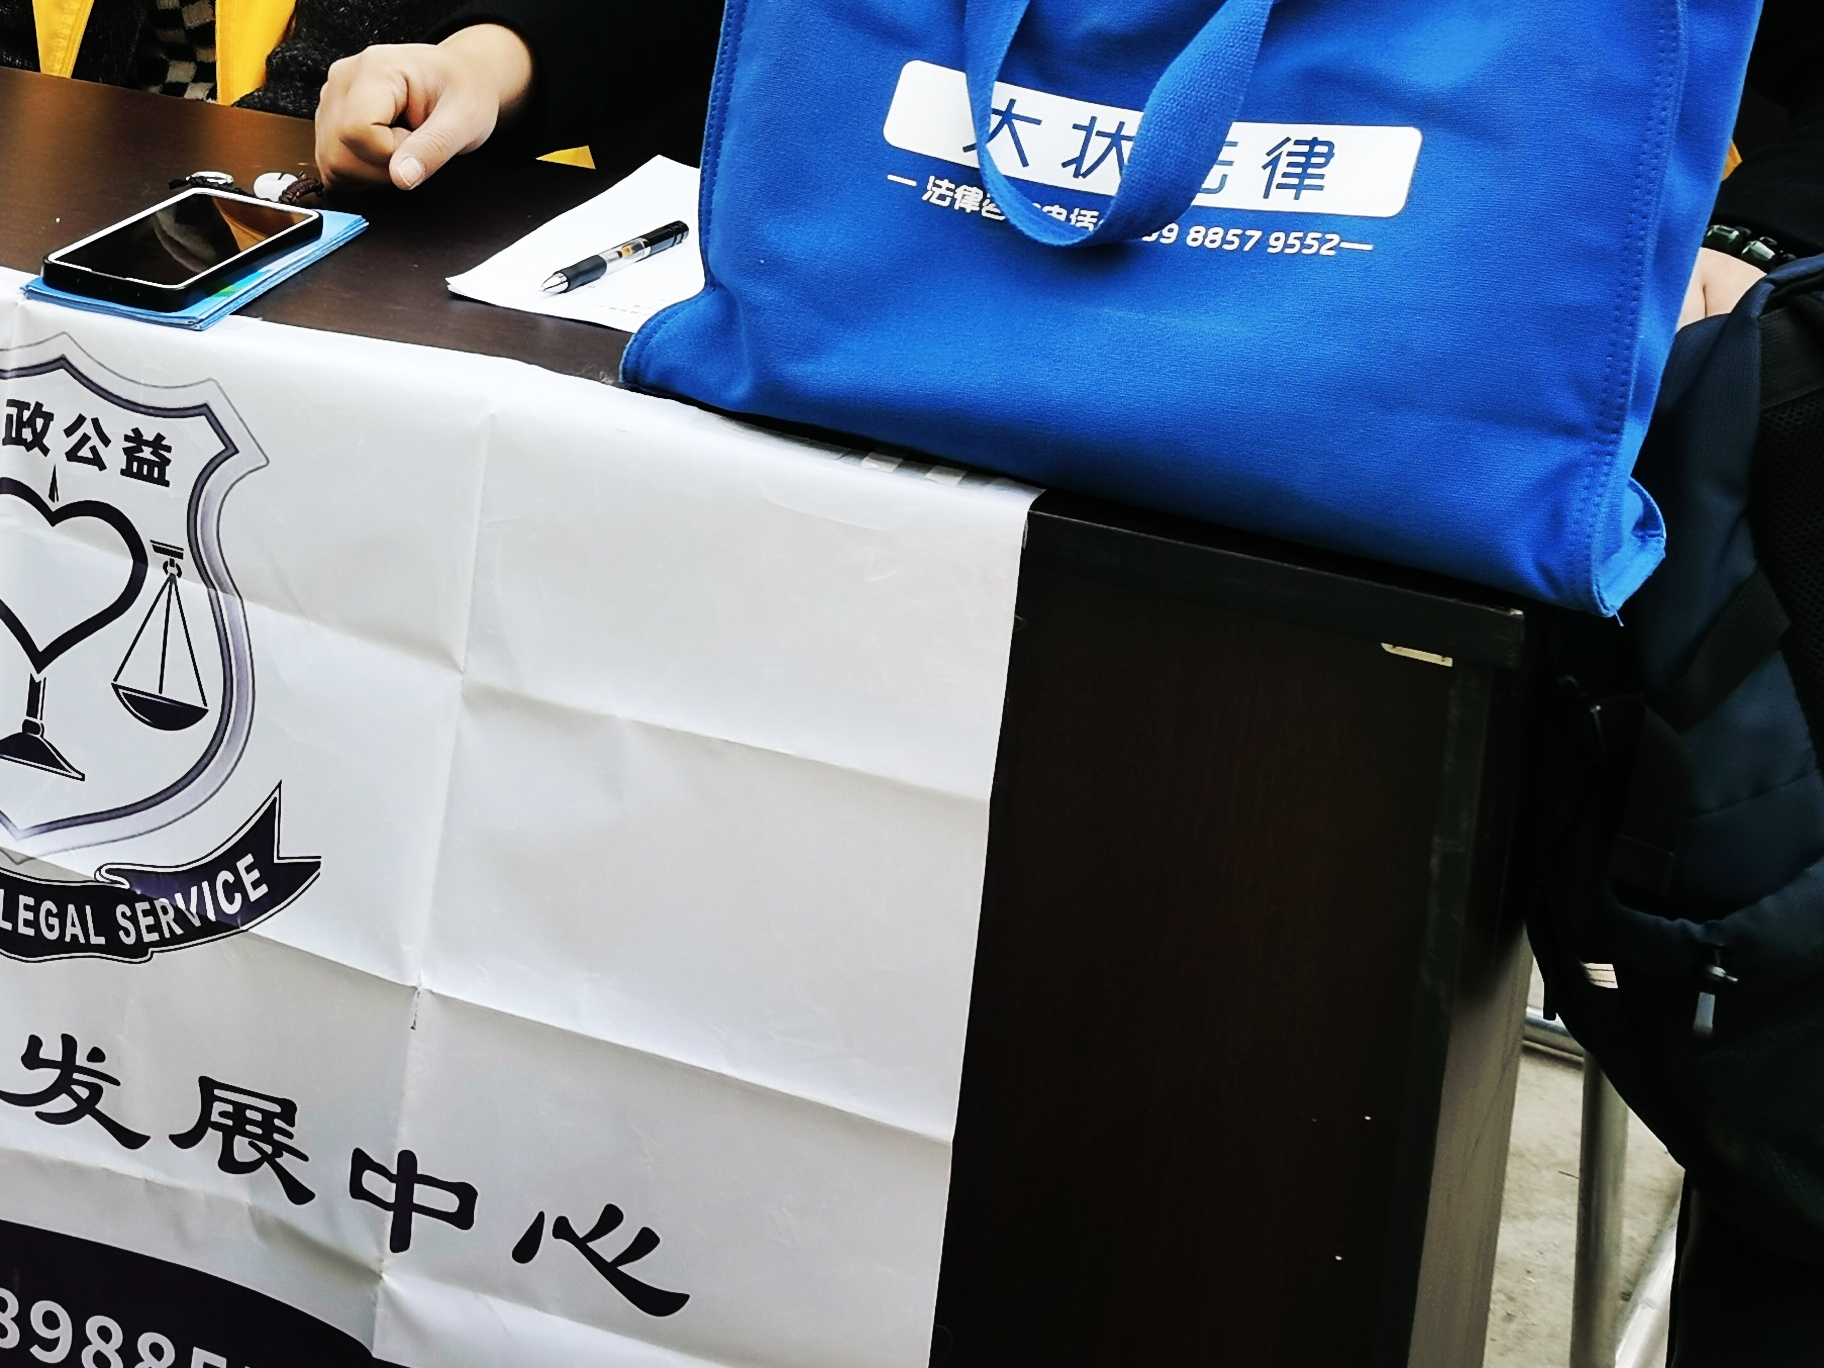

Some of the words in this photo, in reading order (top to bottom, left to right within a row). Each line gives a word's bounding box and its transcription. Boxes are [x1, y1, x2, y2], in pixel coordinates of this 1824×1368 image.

[963, 96, 1336, 201] 大状律
[1186, 224, 1258, 253] 8857
[1266, 230, 1341, 257] 9552
[116, 853, 269, 945] SERVICE
